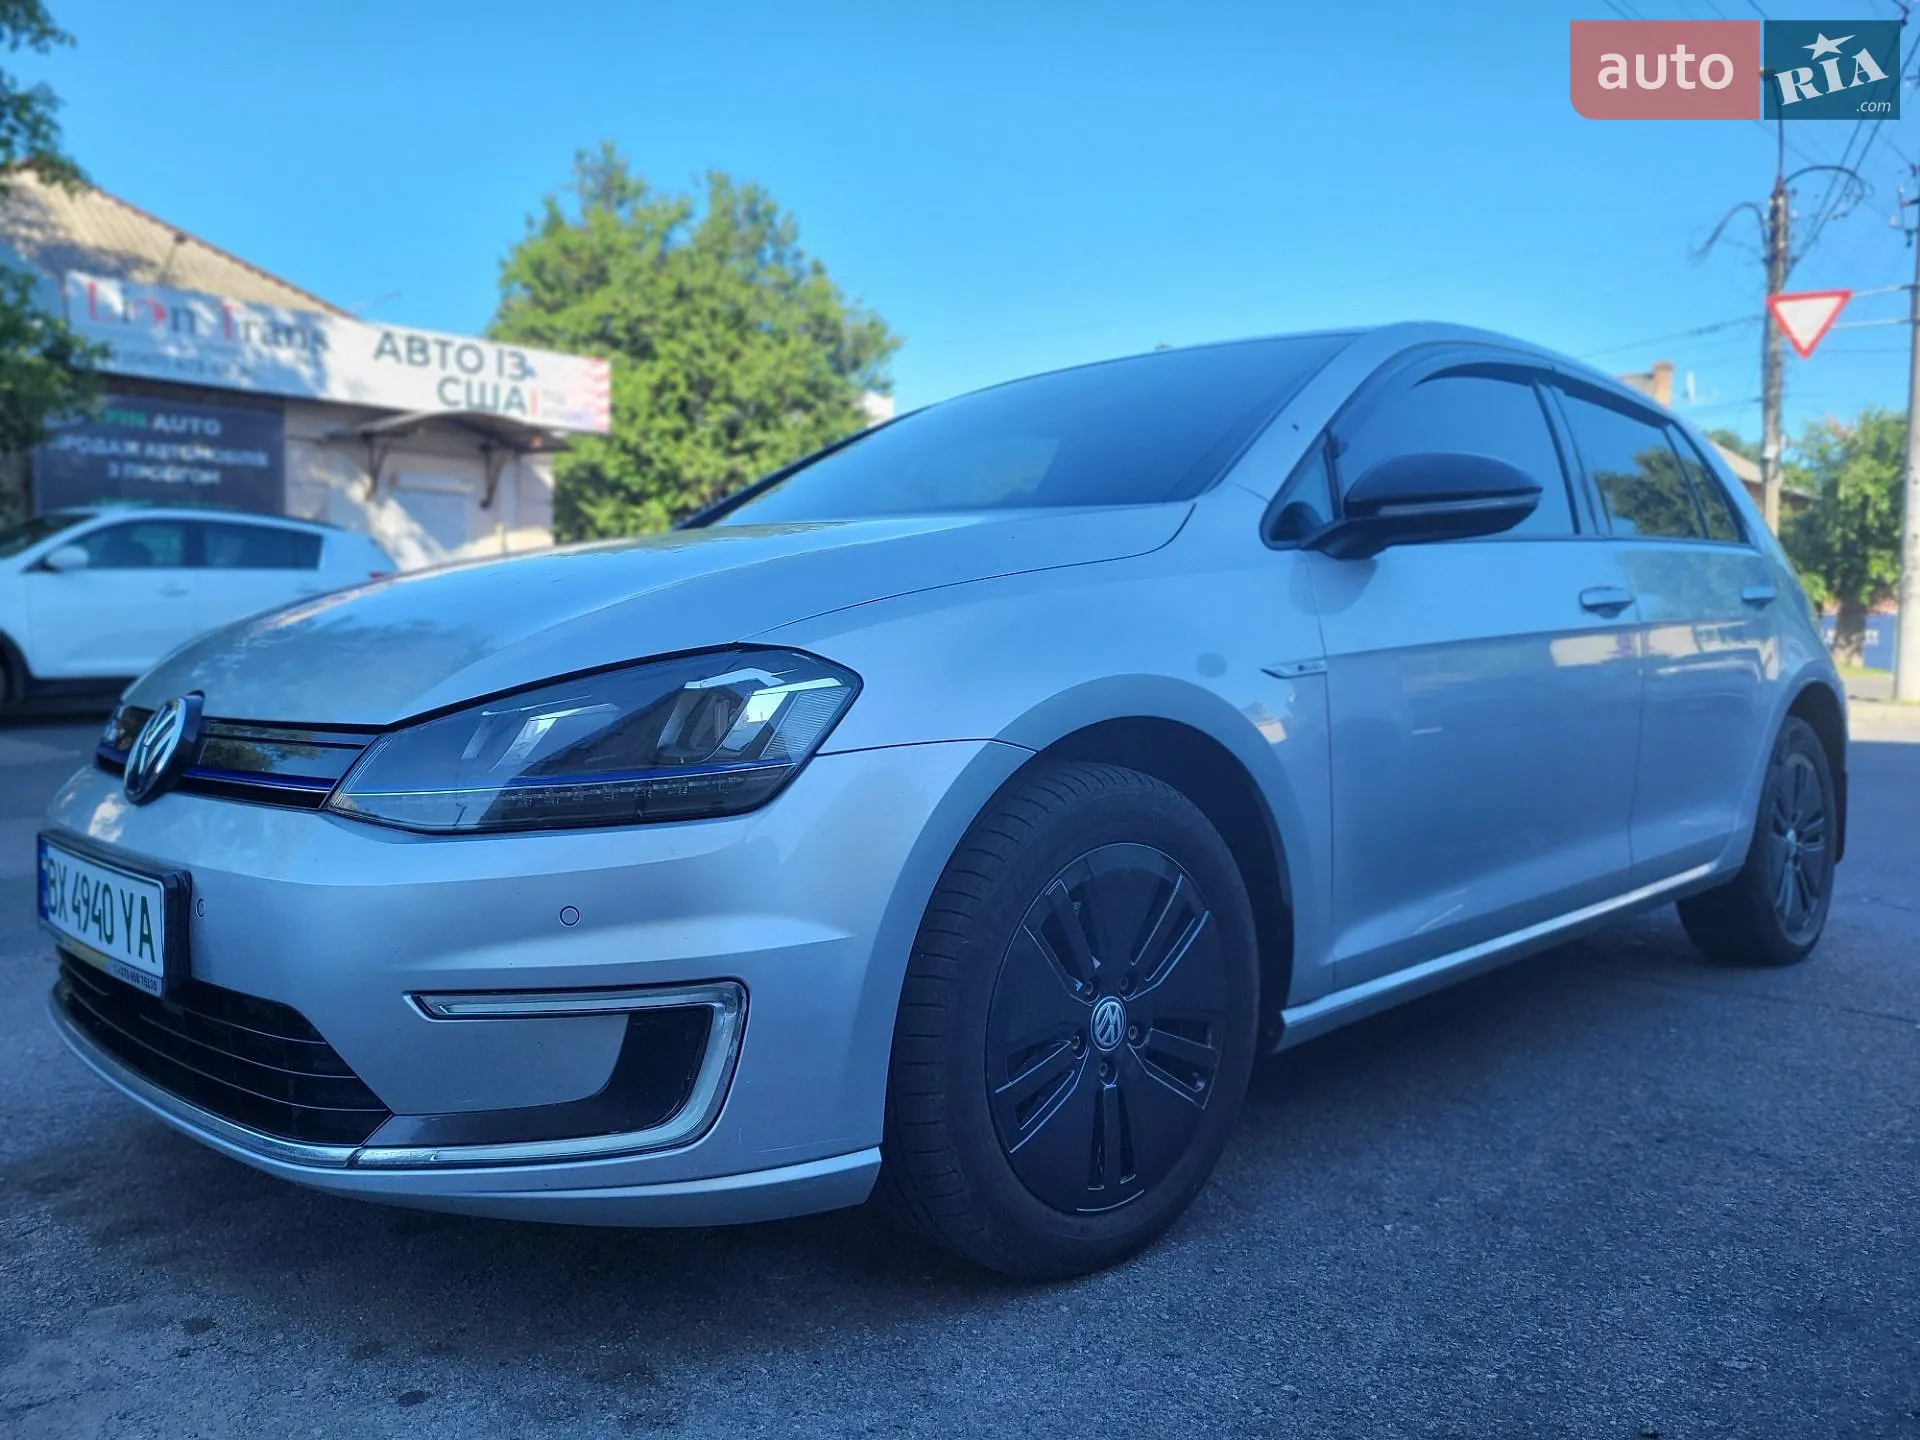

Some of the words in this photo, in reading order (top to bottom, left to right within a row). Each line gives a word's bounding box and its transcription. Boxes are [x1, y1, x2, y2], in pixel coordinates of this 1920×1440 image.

[371, 330, 485, 375] АВТО
[152, 412, 222, 436] AUTO
[71, 871, 115, 945] 4940
[119, 888, 156, 964] YA
